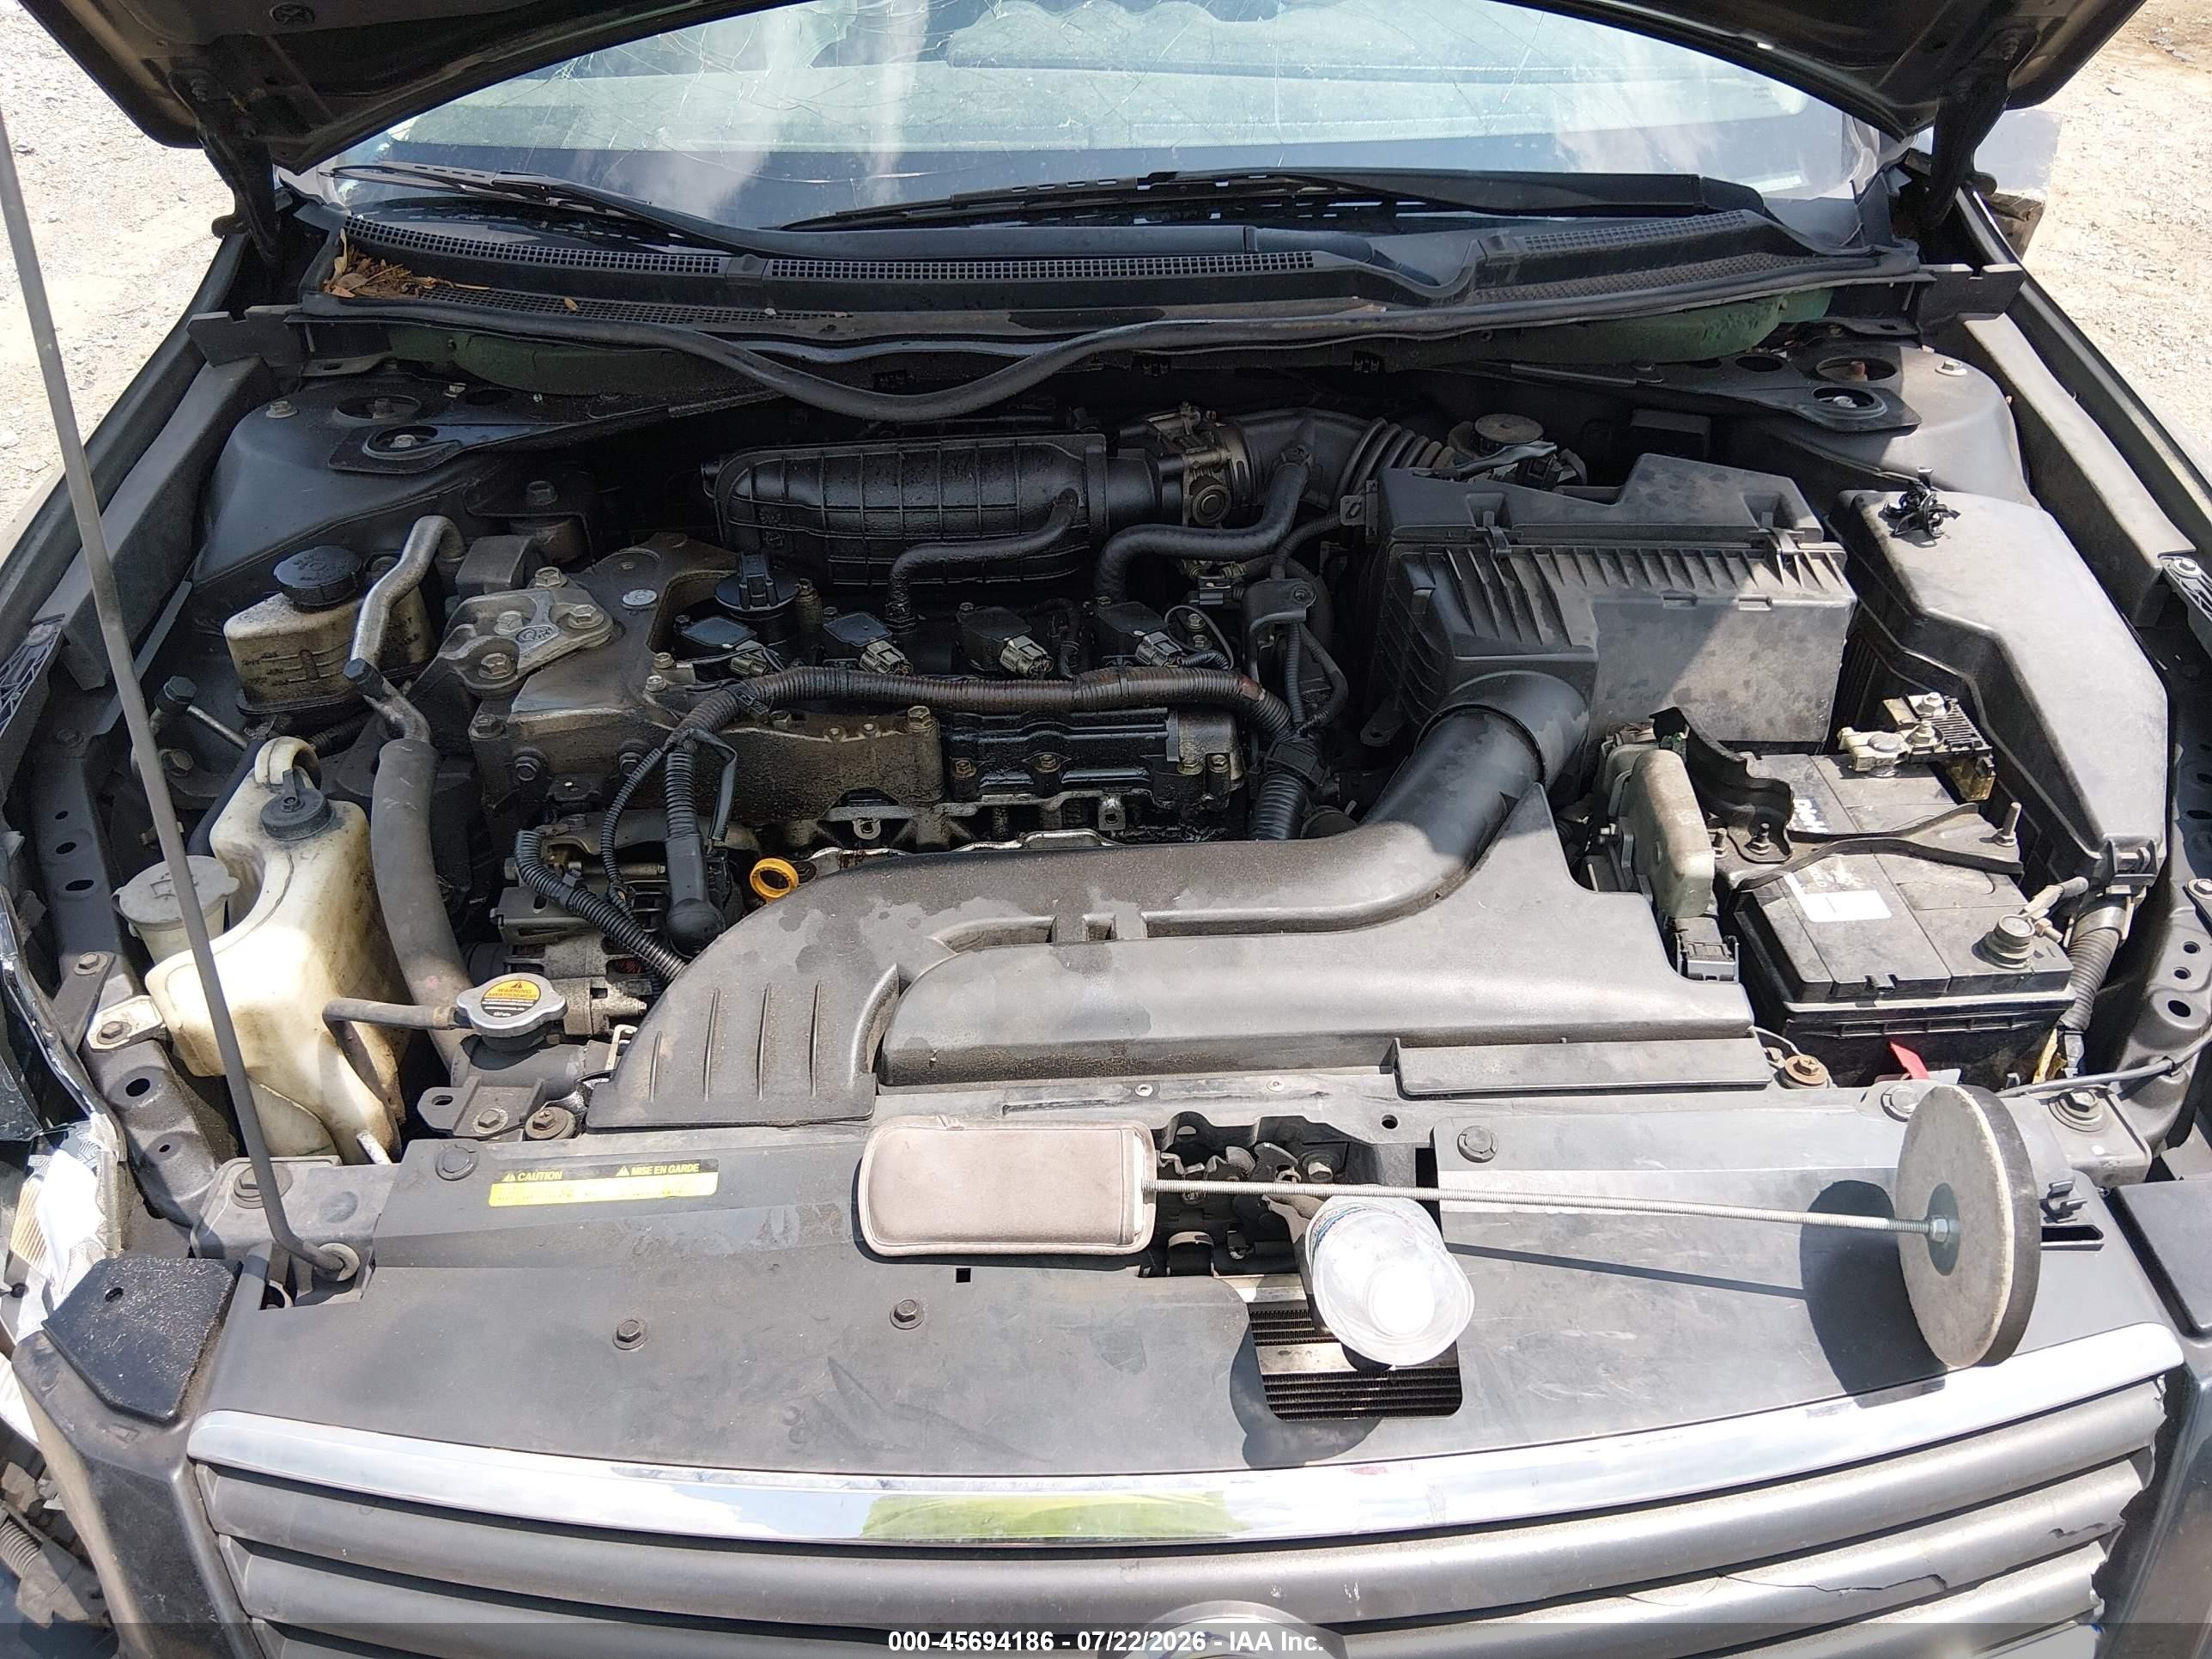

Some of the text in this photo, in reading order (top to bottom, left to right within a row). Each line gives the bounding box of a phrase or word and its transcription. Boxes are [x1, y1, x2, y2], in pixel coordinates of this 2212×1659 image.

[630, 1163, 700, 1176] MISE EN GARDE
[517, 1170, 563, 1182] CAUTION
